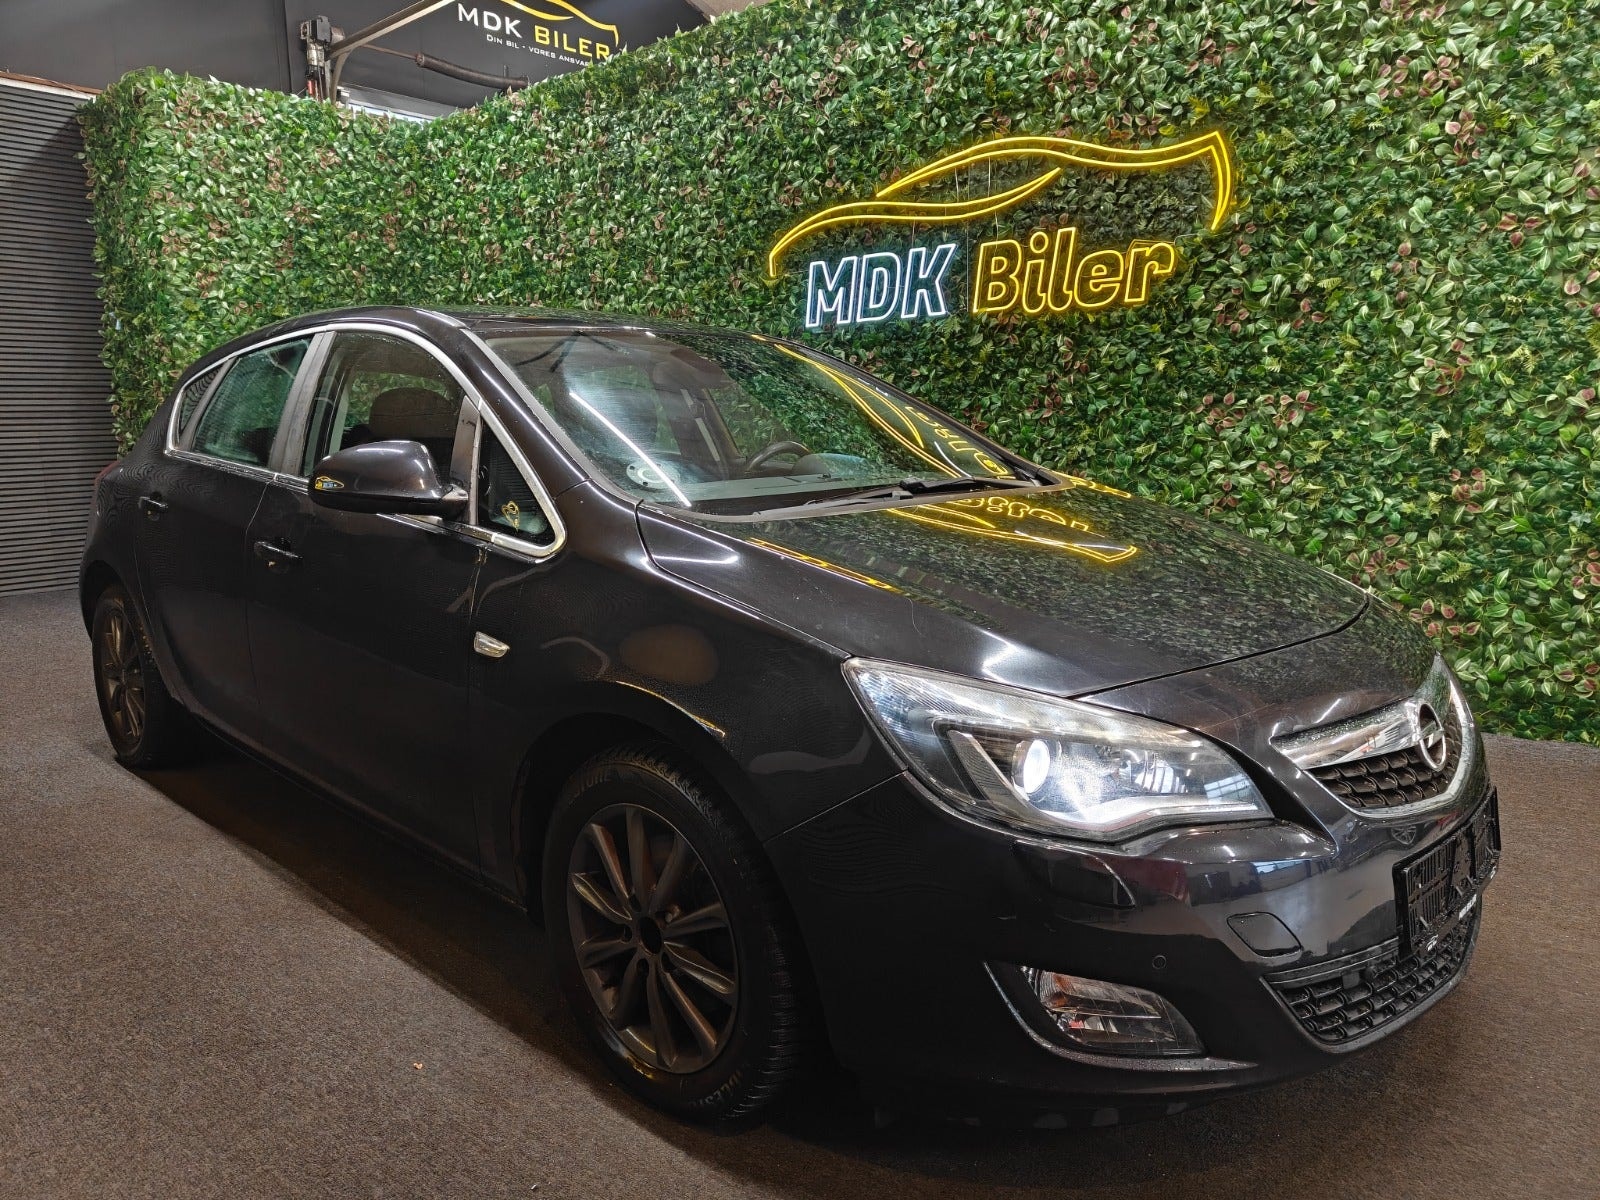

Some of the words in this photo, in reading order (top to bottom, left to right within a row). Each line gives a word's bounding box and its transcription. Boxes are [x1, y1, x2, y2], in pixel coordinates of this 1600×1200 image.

[457, 3, 522, 39] MDK
[534, 24, 610, 60] BILER
[486, 34, 503, 44] DIN
[506, 40, 519, 49] BIL
[529, 46, 556, 59] VORES
[805, 243, 957, 328] MDK
[972, 227, 1176, 314] Biler
